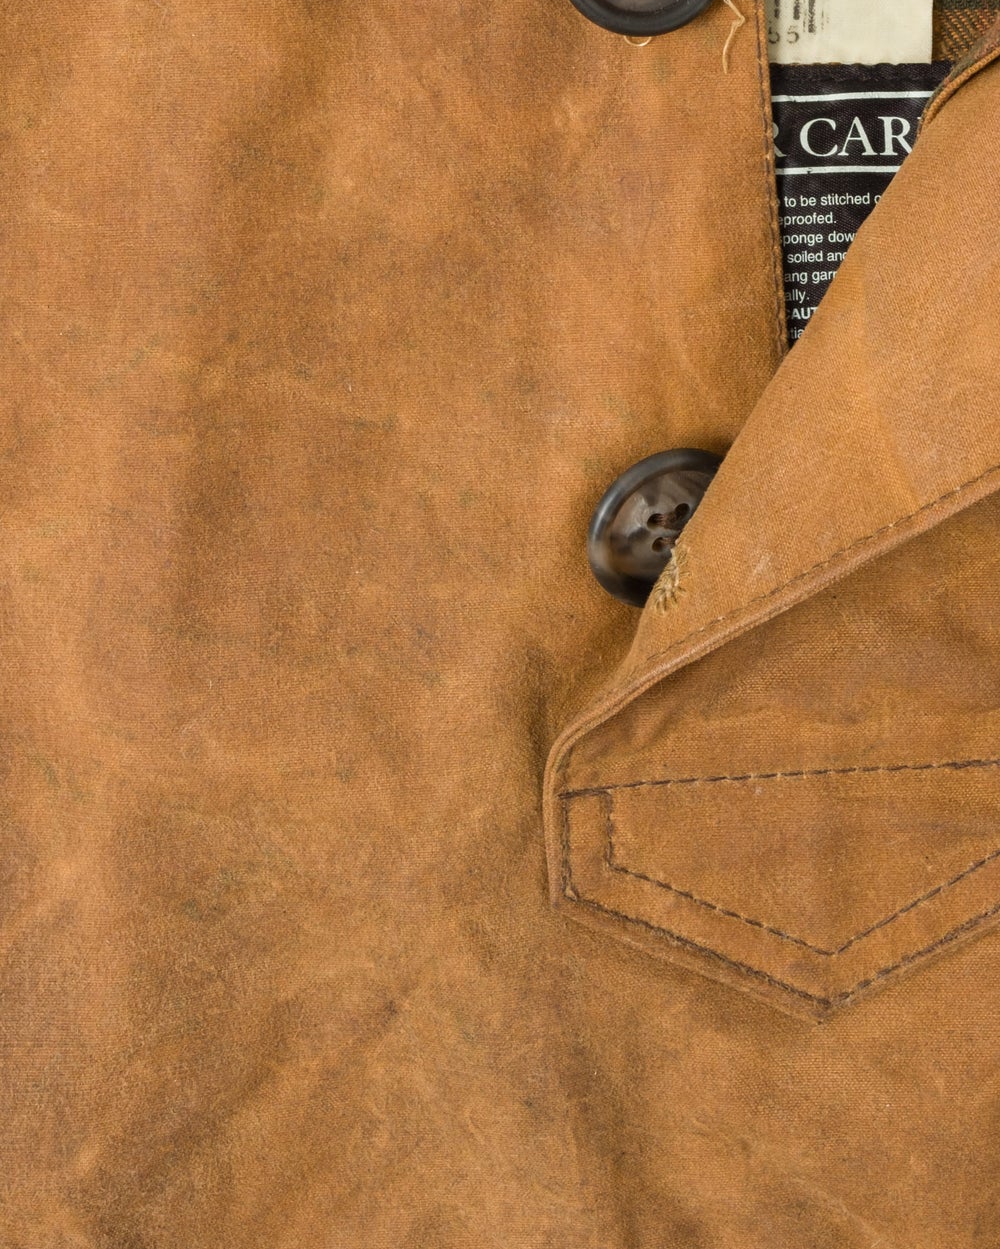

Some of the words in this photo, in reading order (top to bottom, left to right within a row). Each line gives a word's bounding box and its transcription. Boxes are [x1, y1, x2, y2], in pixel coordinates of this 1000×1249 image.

[799, 116, 922, 157] CAR
[784, 196, 797, 207] to
[800, 195, 817, 206] be
[820, 193, 870, 206] stitched
[828, 230, 857, 242] dow
[787, 251, 823, 263] soiled
